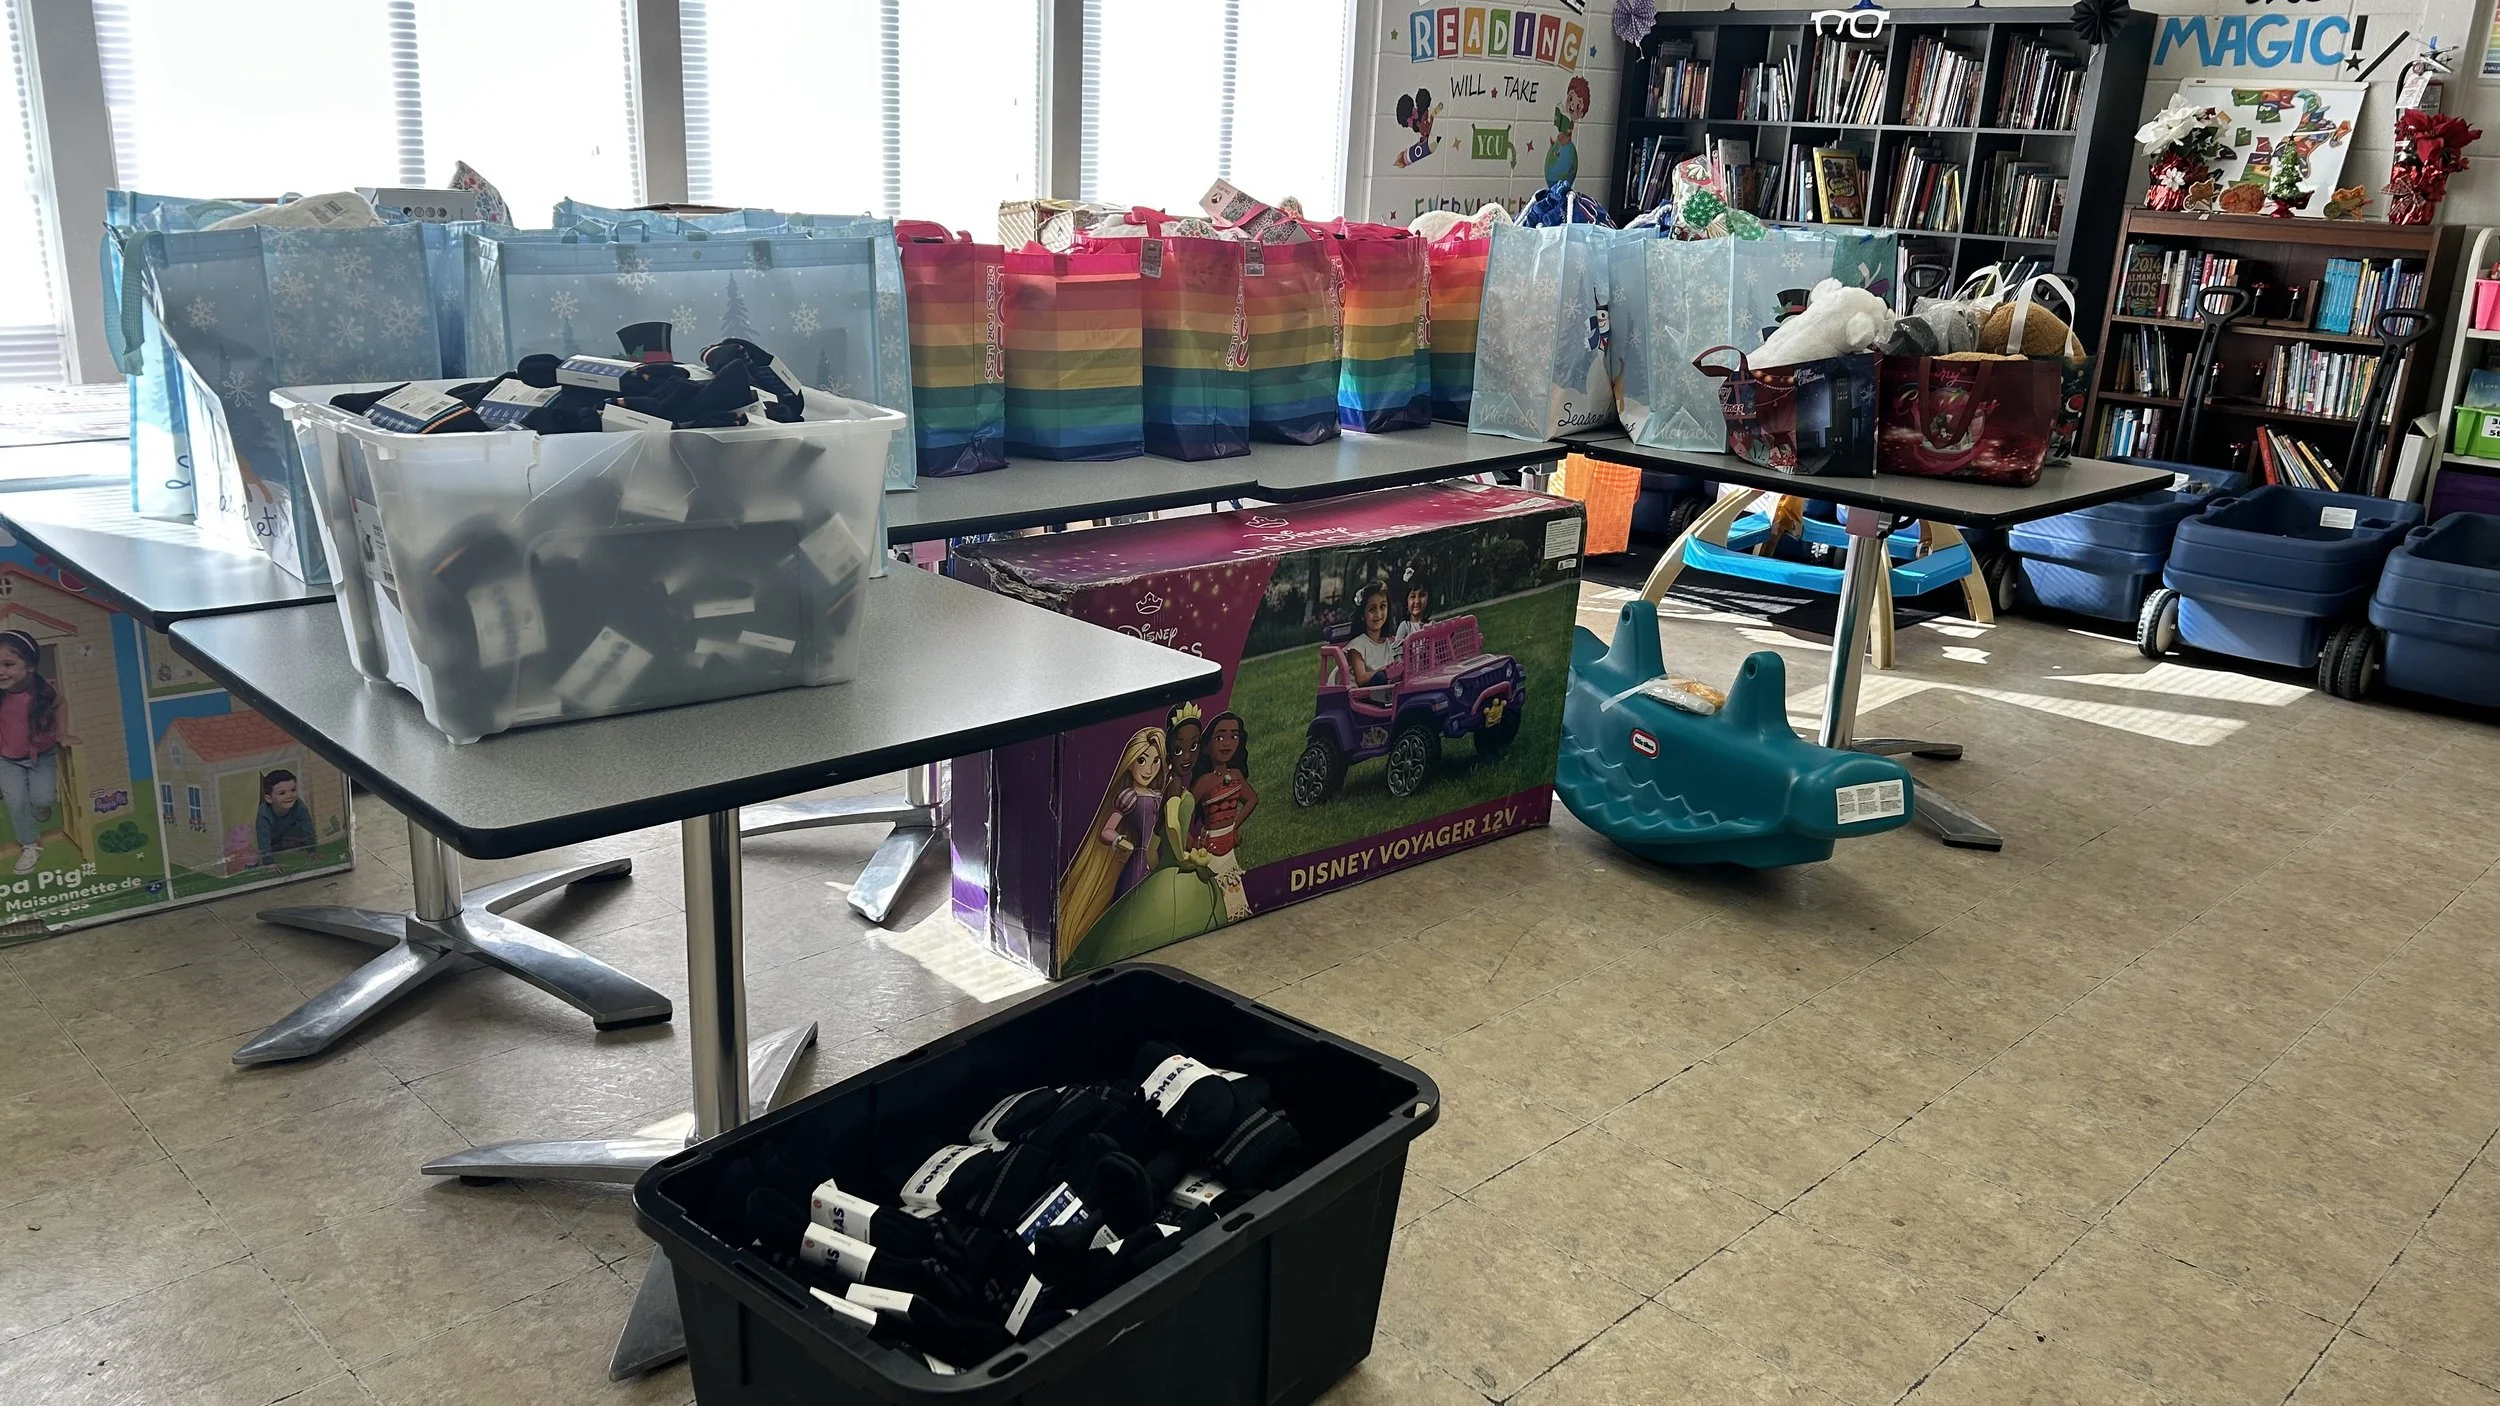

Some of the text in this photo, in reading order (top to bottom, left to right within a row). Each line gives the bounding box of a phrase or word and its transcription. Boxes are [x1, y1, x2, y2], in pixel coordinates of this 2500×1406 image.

[1414, 14, 1578, 62] READING
[1451, 73, 1539, 103] WILL TAKE
[1476, 134, 1505, 157] YOU
[2130, 257, 2161, 273] 2014
[2125, 281, 2158, 298] KIDS
[985, 265, 996, 379] DRESS FOR LESS
[1479, 403, 1538, 428] Michaels
[1290, 806, 1518, 892] DISNEY VOYAGER 12V
[37, 868, 82, 888] Pig
[5, 877, 142, 912] Maisonnette de
[1150, 1062, 1194, 1101] OMBAS
